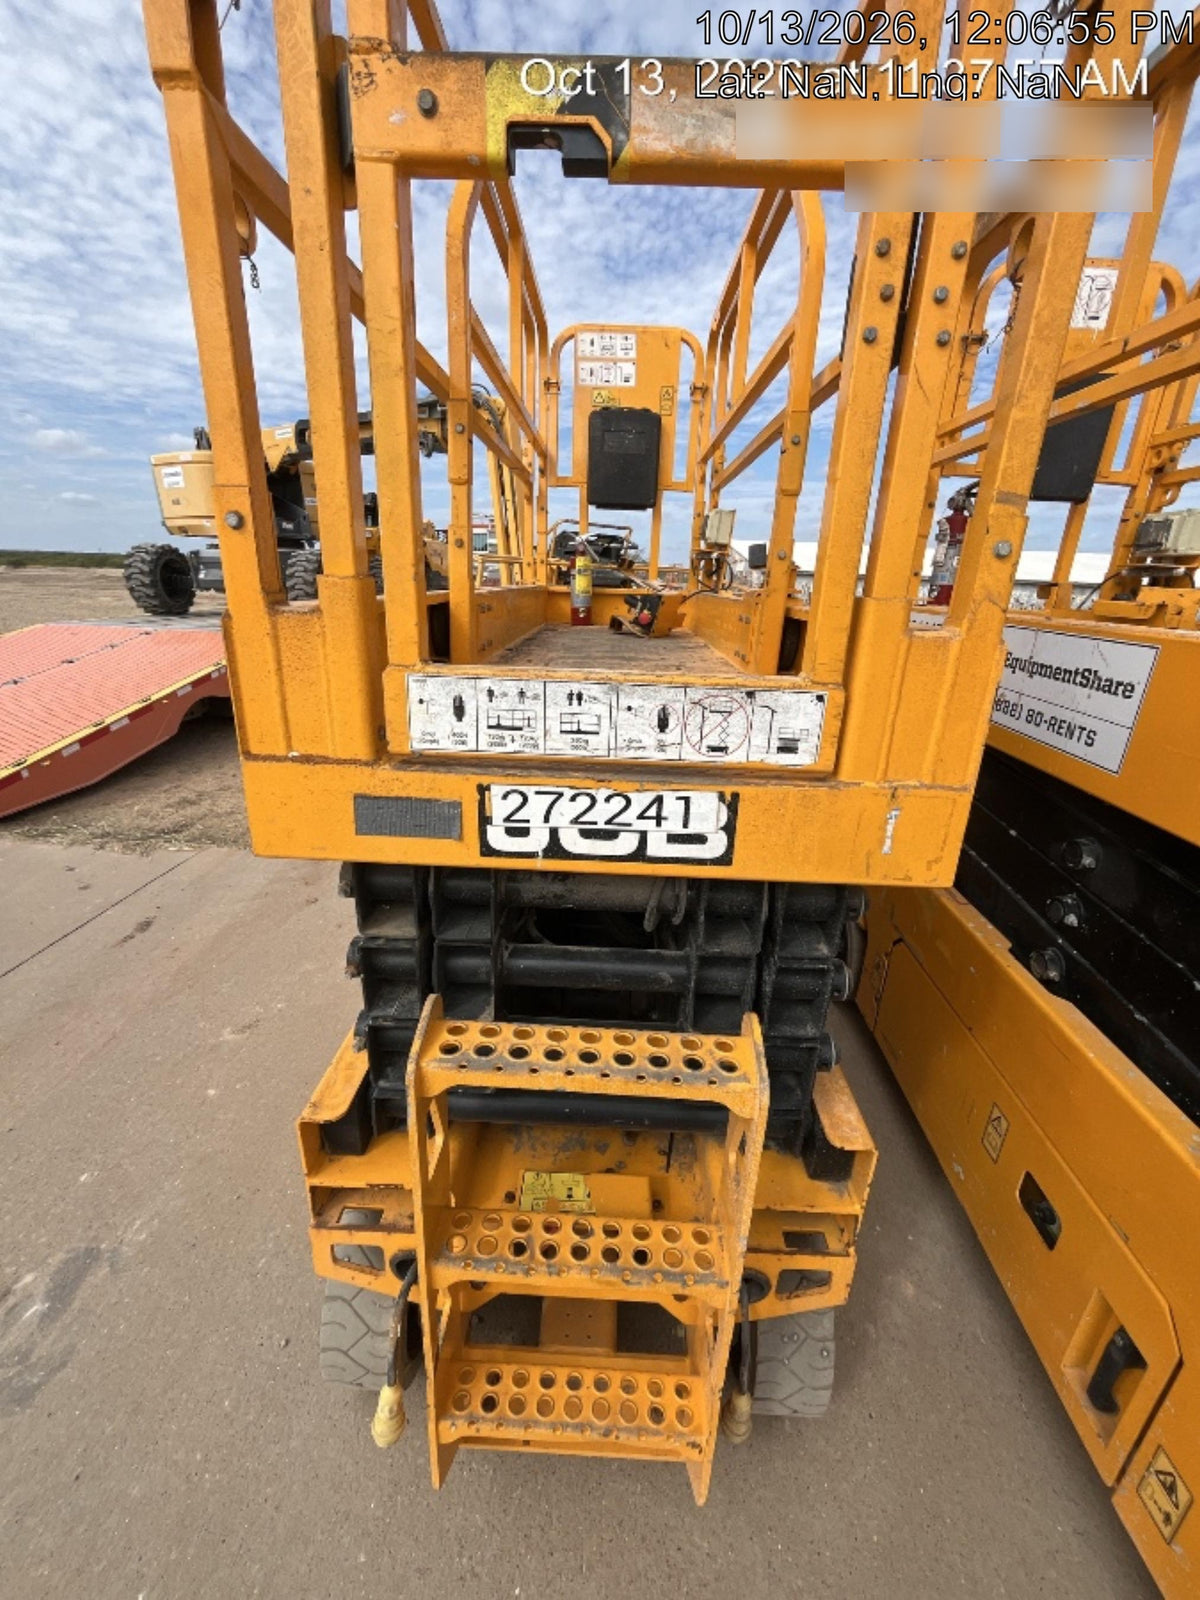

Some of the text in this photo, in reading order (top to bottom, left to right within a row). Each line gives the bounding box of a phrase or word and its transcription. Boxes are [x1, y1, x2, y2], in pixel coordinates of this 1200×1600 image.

[1004, 651, 1135, 699] EquipmentShare
[1025, 708, 1097, 747] 80-RENTS
[500, 789, 692, 830] 272241
